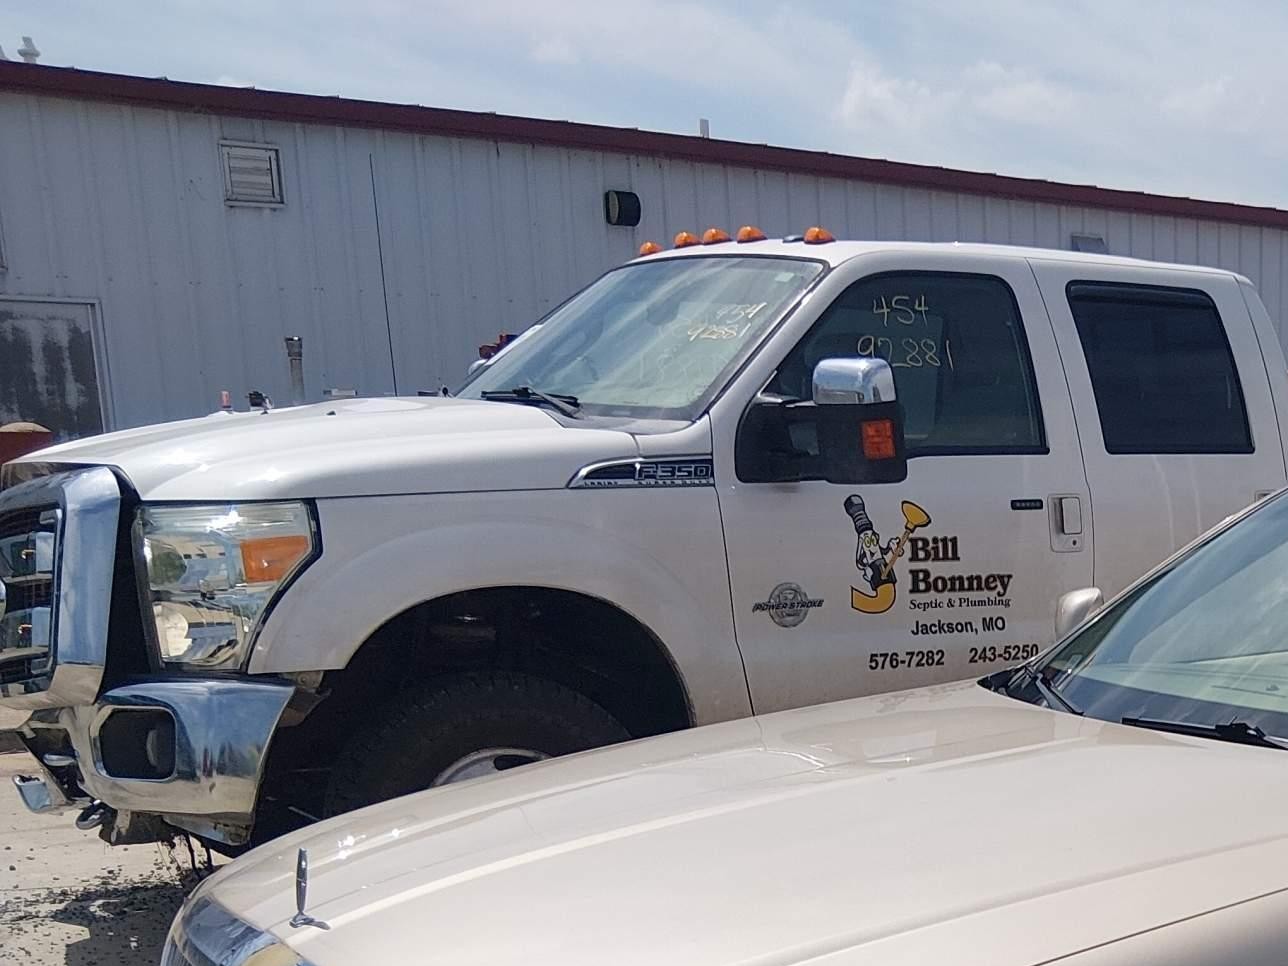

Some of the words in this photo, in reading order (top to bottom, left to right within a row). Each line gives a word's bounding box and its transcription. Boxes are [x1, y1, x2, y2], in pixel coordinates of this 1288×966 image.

[873, 295, 929, 327] 454
[857, 335, 954, 372] 92881
[908, 536, 960, 562] Bill
[908, 568, 1013, 597] Bonney
[788, 599, 824, 610] STROKE
[909, 599, 943, 611] Septic
[946, 598, 955, 608] &
[958, 597, 1012, 609] Plumbing
[911, 620, 979, 635] Jackson,
[982, 616, 1006, 631] MO
[869, 650, 945, 670] 576-7282
[968, 644, 1039, 664] 243-5250
